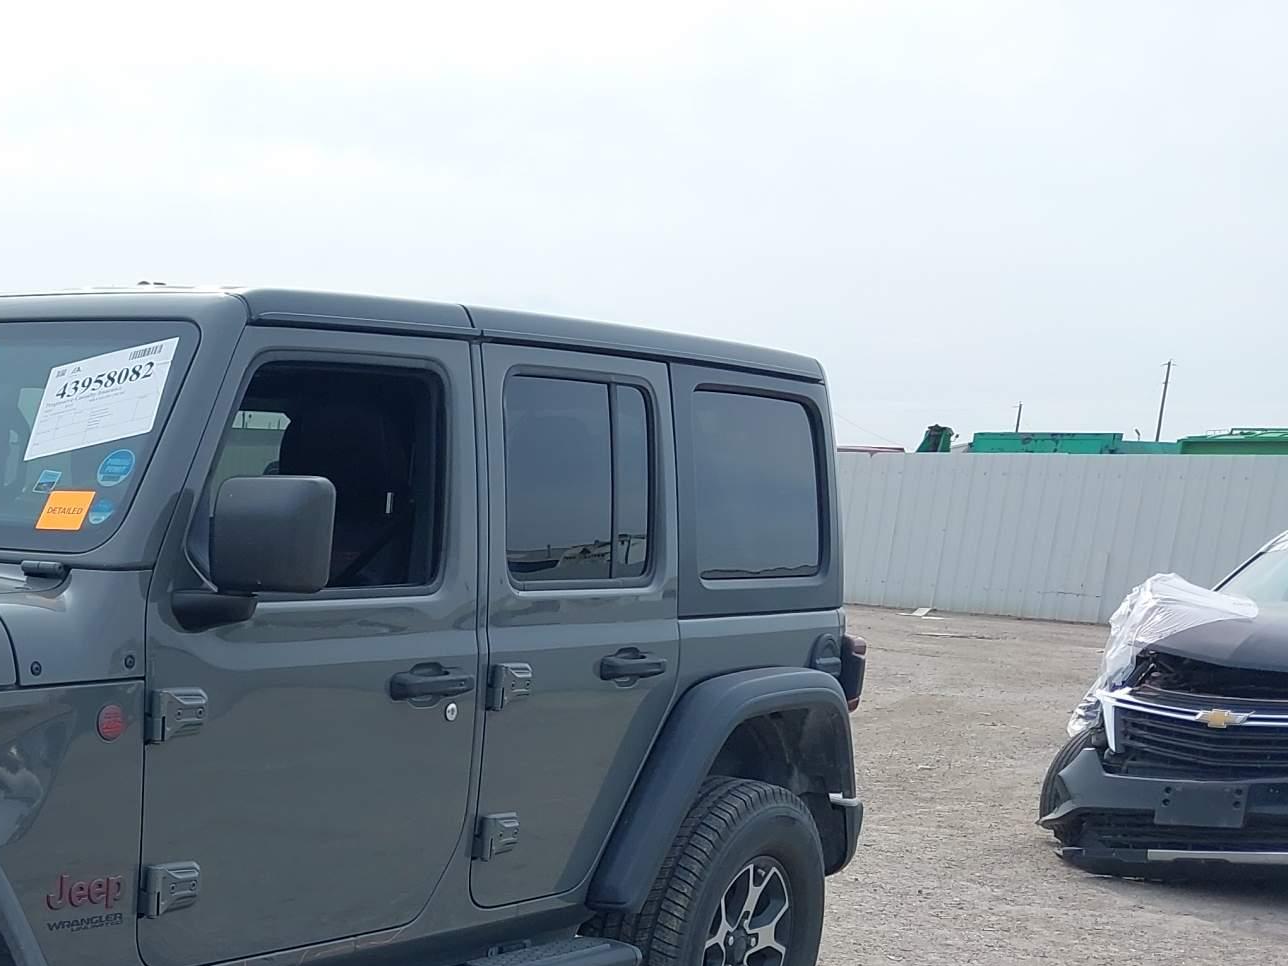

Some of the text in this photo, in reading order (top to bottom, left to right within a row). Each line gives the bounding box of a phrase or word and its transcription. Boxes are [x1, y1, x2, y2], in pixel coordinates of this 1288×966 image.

[56, 361, 154, 399] 43958082
[46, 506, 84, 515] DETAILED
[46, 874, 123, 911] Jeep
[47, 912, 122, 931] WRANGLER
